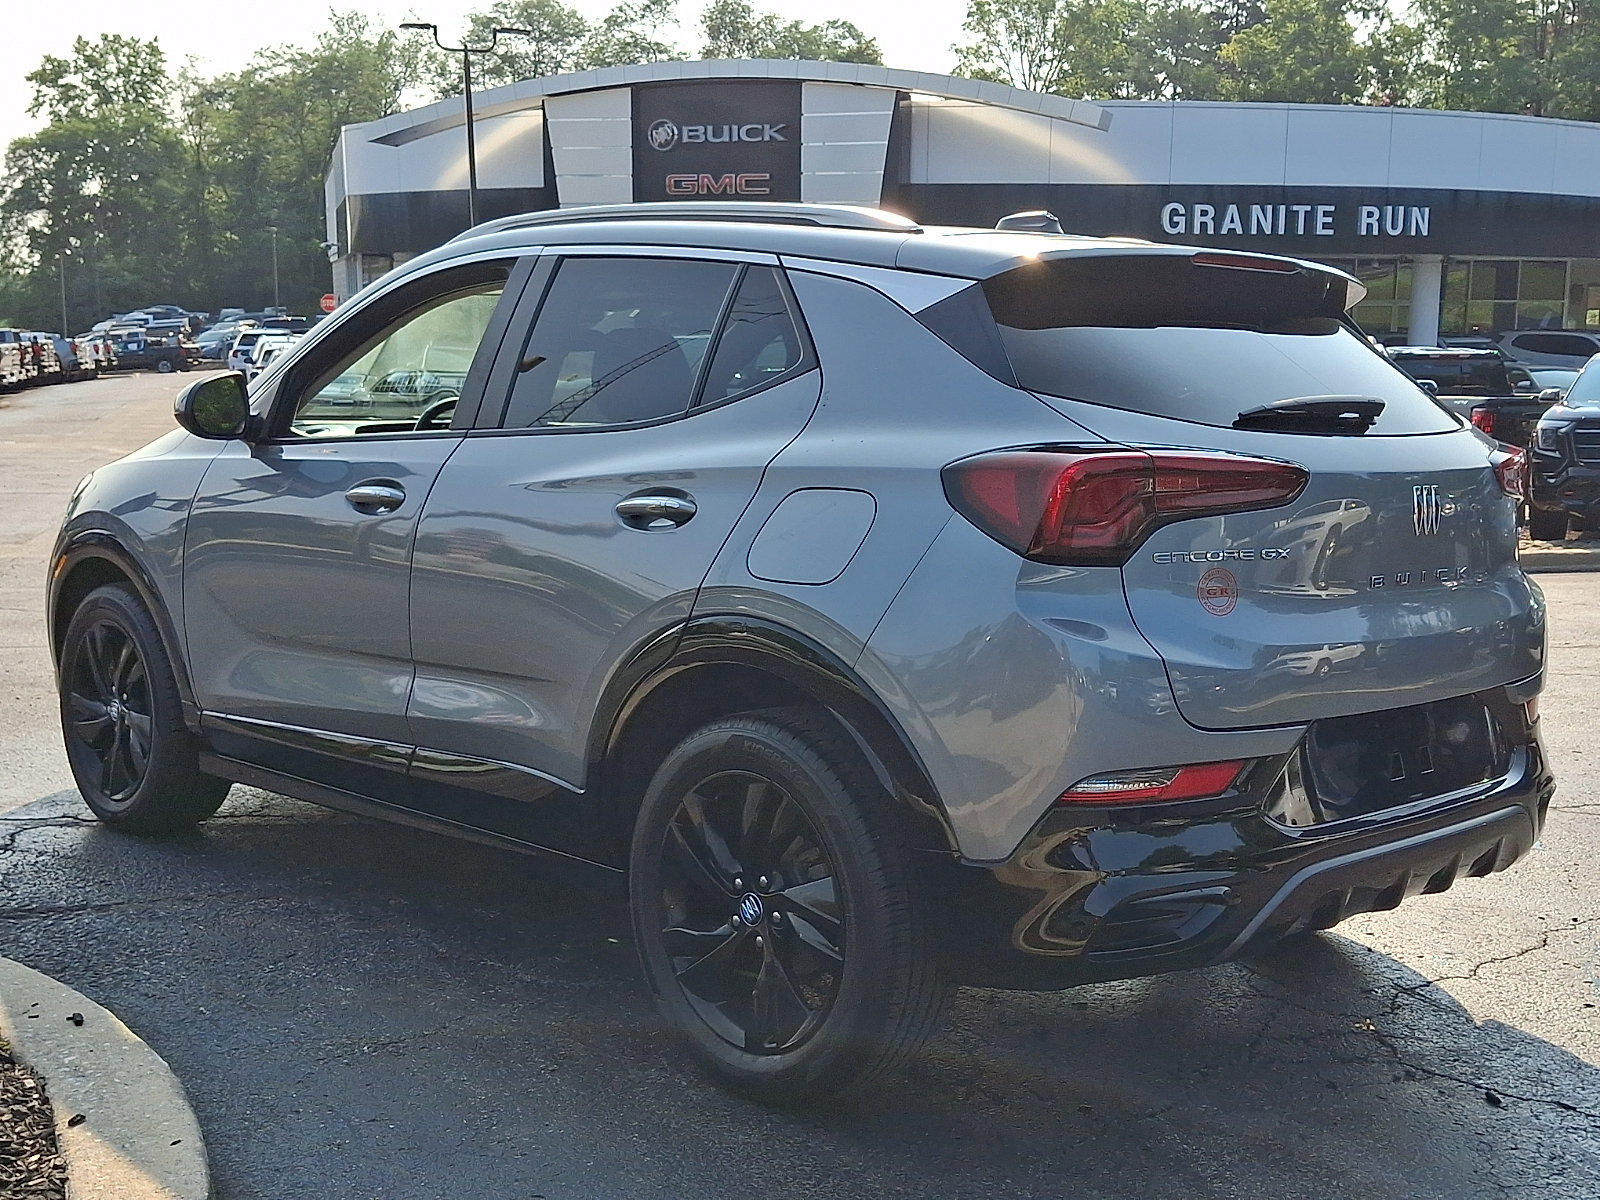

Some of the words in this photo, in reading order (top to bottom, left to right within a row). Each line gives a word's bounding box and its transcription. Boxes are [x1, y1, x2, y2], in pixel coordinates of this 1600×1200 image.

[682, 123, 789, 143] BUICK
[665, 173, 771, 195] GMC
[1160, 202, 1336, 235] GRANITE
[1358, 205, 1431, 236] RUN
[1152, 549, 1255, 564] ENCORE
[1261, 547, 1291, 560] GX
[1369, 566, 1468, 589] BUICK
[1206, 588, 1229, 596] GR
